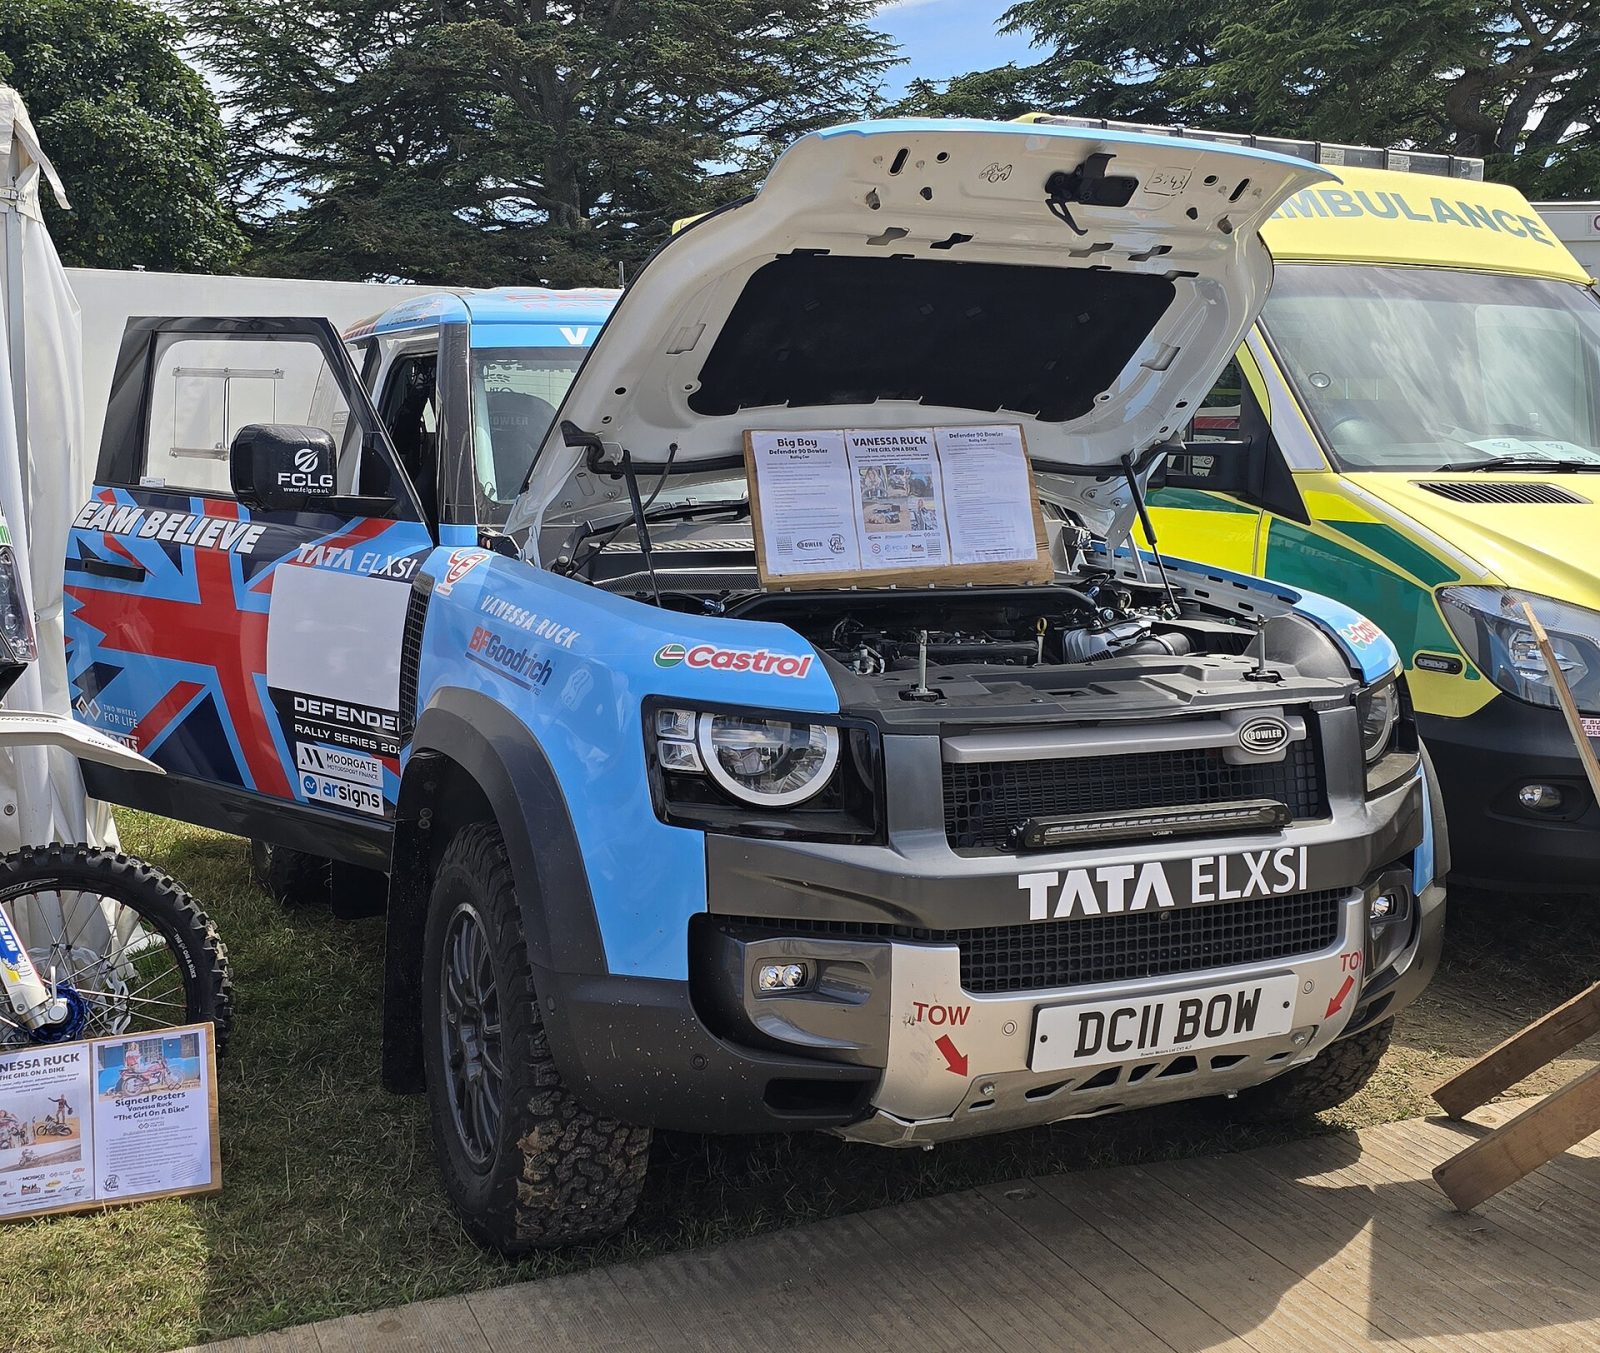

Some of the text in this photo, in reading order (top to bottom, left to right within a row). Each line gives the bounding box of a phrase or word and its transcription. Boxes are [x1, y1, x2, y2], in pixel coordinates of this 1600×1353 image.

[490, 416, 529, 426] OWLER
[776, 438, 817, 449] Big Boy
[852, 436, 927, 447] VANESSA RUCK
[277, 472, 333, 487] FCLG
[71, 500, 267, 555] EAM BELIEVE
[296, 542, 418, 580] TATA ELXSI
[480, 595, 581, 649] VANESSA RUCK
[469, 625, 553, 686] BFGoodrich
[687, 646, 812, 677] Castrol
[104, 712, 138, 729] FOR LIFE
[294, 723, 331, 739] RALLY
[334, 732, 377, 750] SERIES
[1249, 729, 1283, 740] BOWLER
[326, 753, 378, 773] MOORGATE
[322, 782, 380, 808] arsigns
[1018, 846, 1308, 921] TATA ELXSI
[1340, 949, 1362, 972] TO
[913, 1001, 971, 1026] TOW
[1173, 988, 1262, 1044] BOW
[43, 1052, 80, 1067] RUCK
[13, 1071, 29, 1079] GIRL
[115, 1091, 186, 1108] Signed Posters
[128, 1104, 156, 1112] Vanessa
[133, 1111, 148, 1119] Girl
